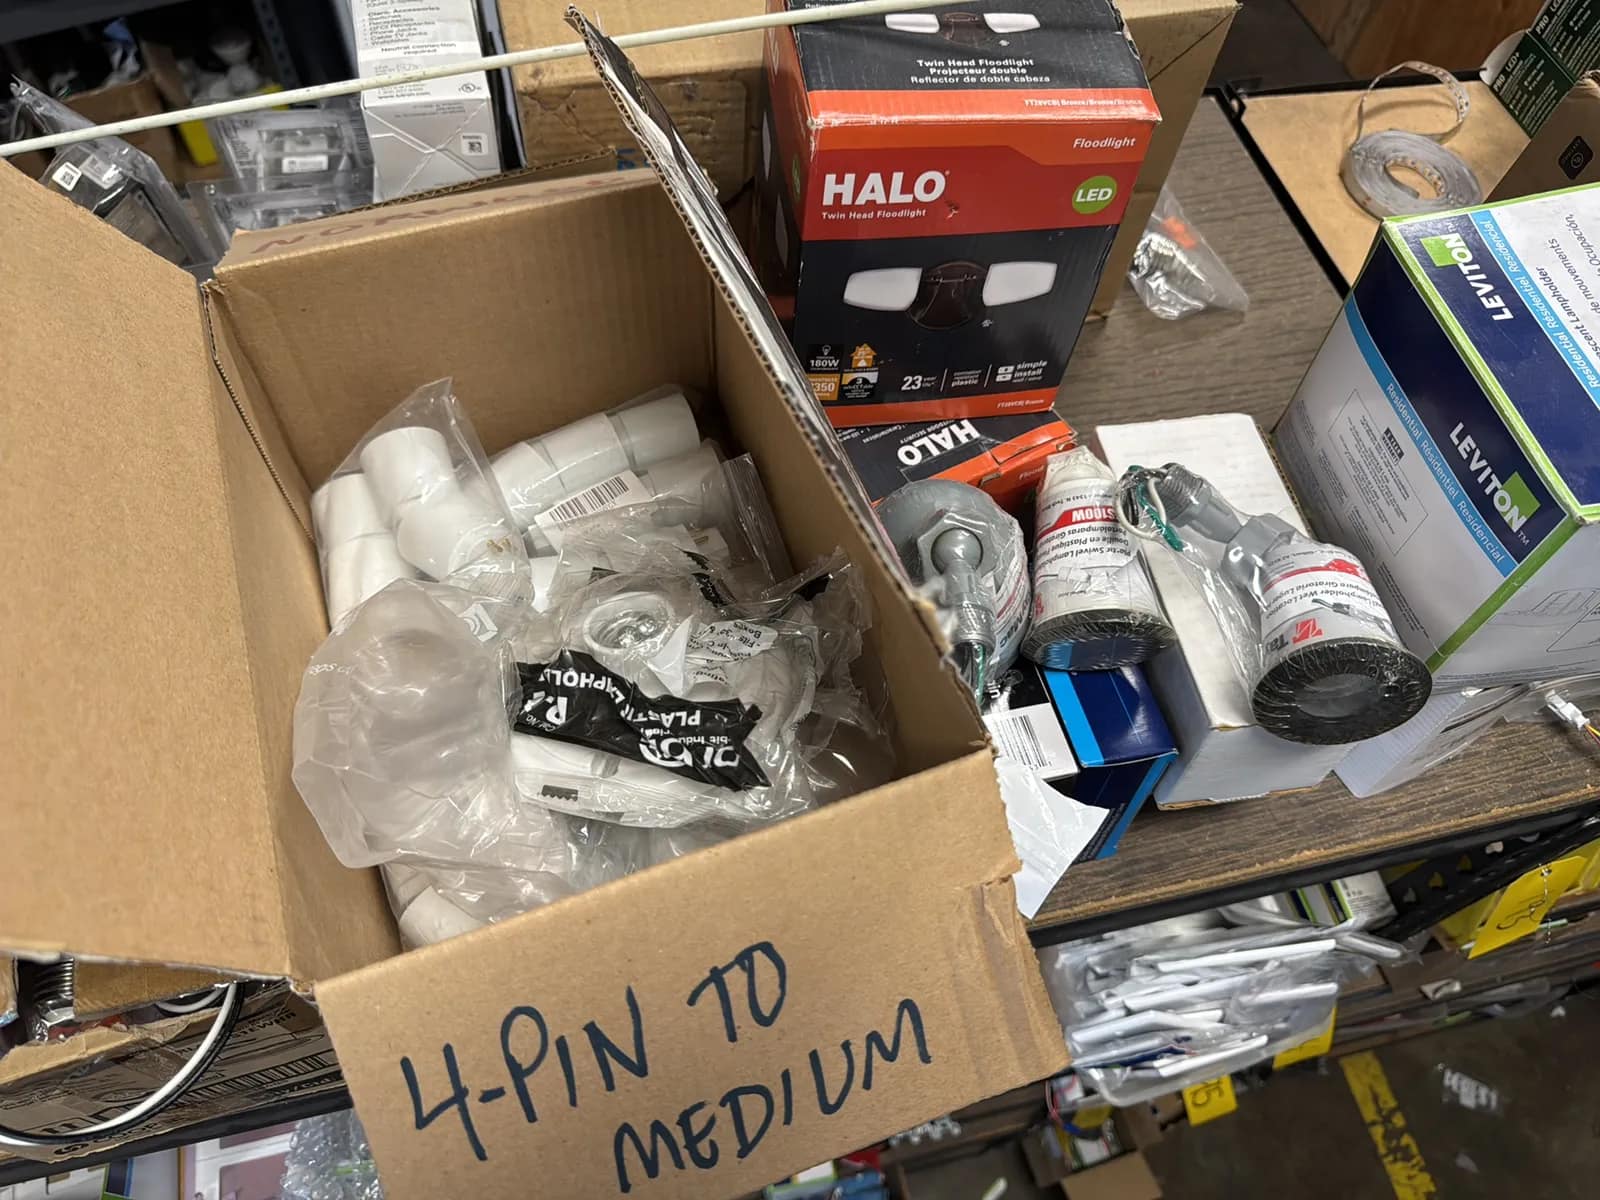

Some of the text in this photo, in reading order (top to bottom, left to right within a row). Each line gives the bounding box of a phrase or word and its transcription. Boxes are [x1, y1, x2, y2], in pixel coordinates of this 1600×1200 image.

[916, 57, 1034, 67] Twin Head Floodlight
[910, 74, 1050, 84] Reflector de doble cabeza
[929, 66, 1027, 76] Projecteur double
[1072, 136, 1137, 149] Floodlight
[821, 170, 946, 206] HALO
[1074, 187, 1114, 204] LED
[821, 208, 927, 221] Twin Head Floodlight
[1440, 232, 1514, 321] LEVITON
[1548, 238, 1594, 301] mouvements
[1479, 219, 1600, 389] Residential Résidentiel Residencial
[1535, 266, 1580, 328] Lampholder
[809, 359, 840, 368] 180W
[1016, 360, 1048, 370] simple
[1013, 367, 1043, 378] install
[901, 375, 922, 391] 23
[951, 379, 979, 387] plastic
[897, 419, 981, 466] HALO
[900, 426, 930, 444] SECURITY
[1386, 383, 1423, 441] Residential
[1420, 439, 1459, 500] Résidentiel
[1456, 500, 1505, 563] Residencial
[1449, 421, 1528, 534] LEVITON
[1075, 546, 1105, 557] Swivel
[1299, 589, 1319, 601] Wet
[400, 941, 788, 1162] 4-PIN TO
[613, 998, 932, 1194] MEDIUM
